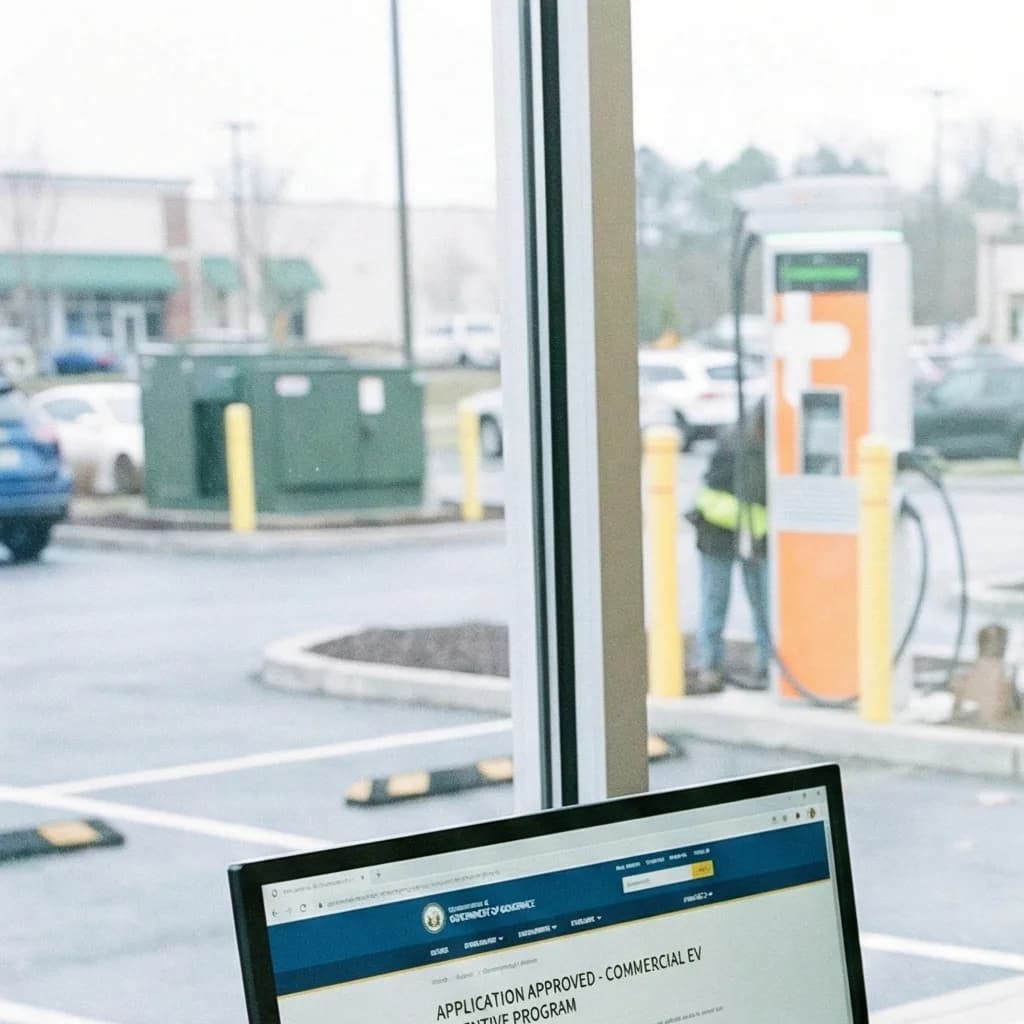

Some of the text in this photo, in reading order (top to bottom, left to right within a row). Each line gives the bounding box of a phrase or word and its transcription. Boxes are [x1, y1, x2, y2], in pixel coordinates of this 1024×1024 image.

[436, 988, 525, 1021] APPLICATION
[527, 971, 596, 1000] APPROVED
[605, 950, 686, 982] COMMERCIAL
[687, 945, 703, 964] EV
